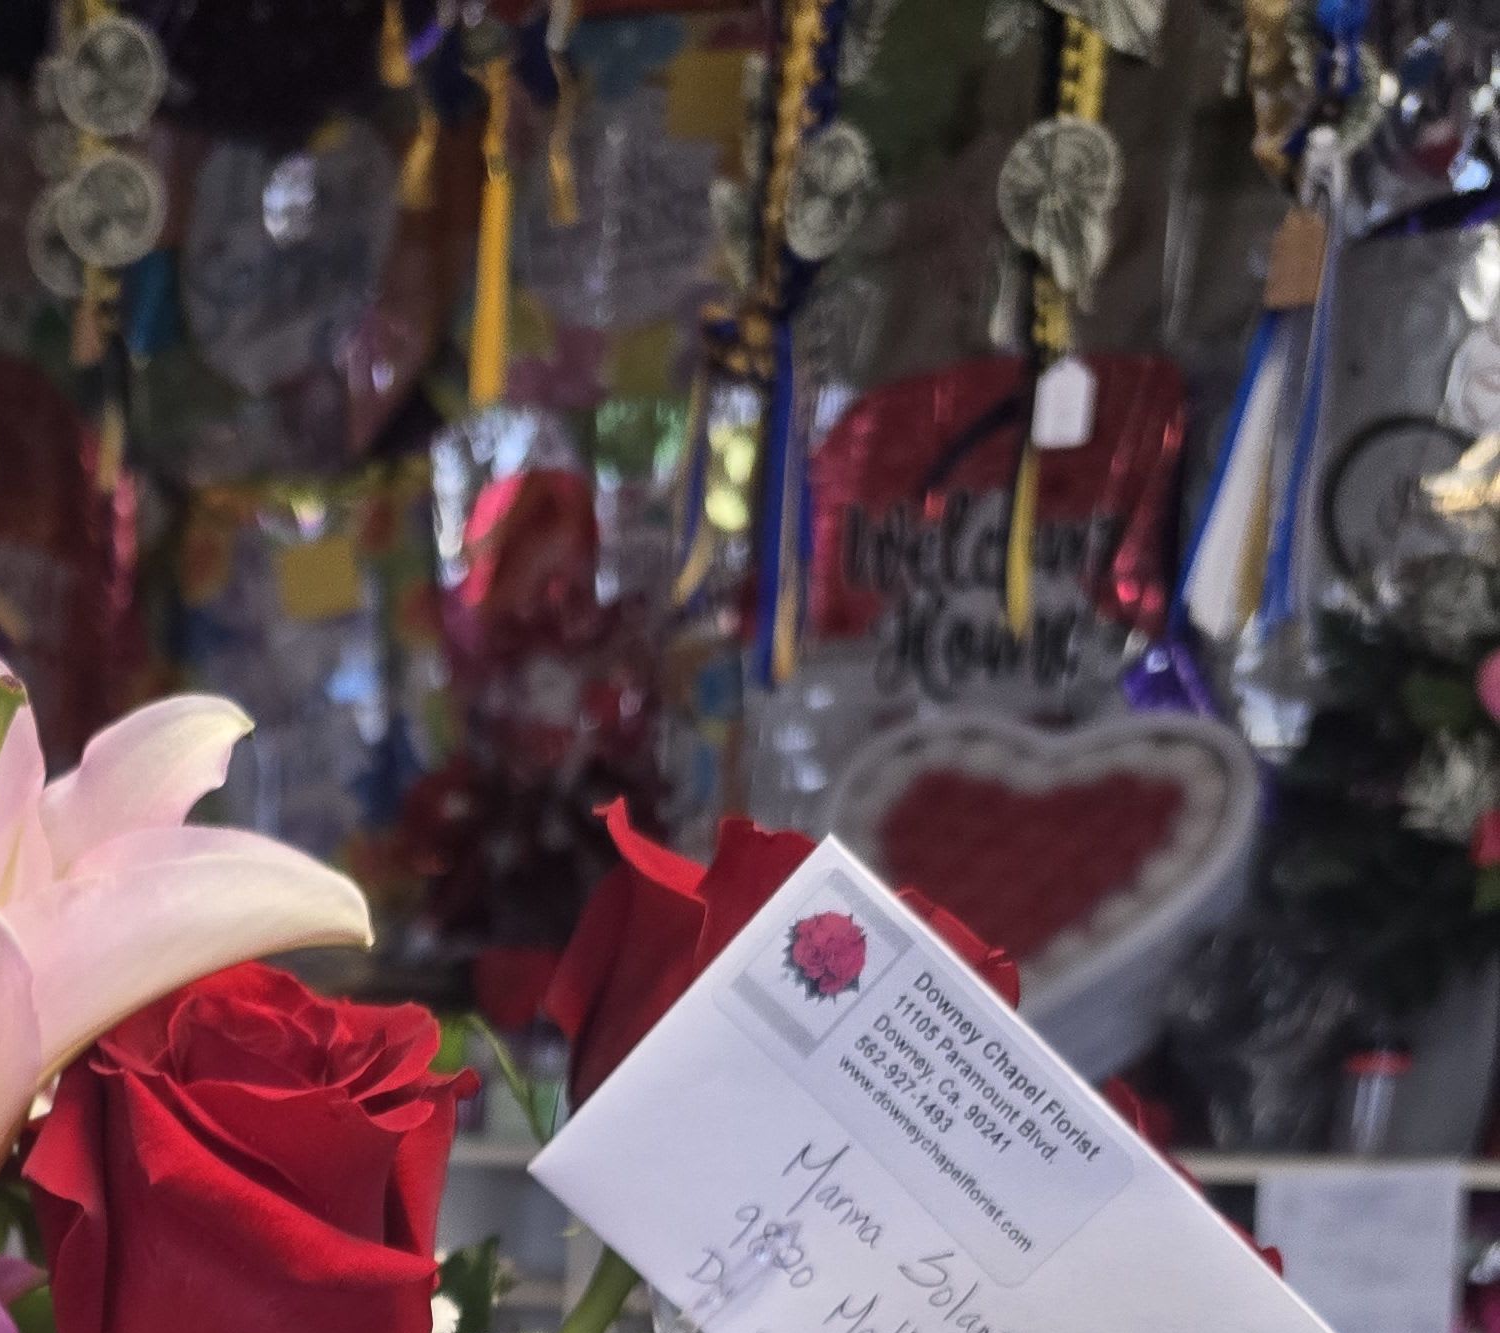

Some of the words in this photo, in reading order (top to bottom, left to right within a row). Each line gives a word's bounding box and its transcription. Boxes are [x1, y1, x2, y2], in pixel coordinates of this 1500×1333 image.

[854, 1035, 953, 1134] 562-927-1493
[873, 1014, 934, 1085] Downey,
[938, 1079, 962, 1109] Ca.
[964, 1104, 1012, 1154] 90241
[894, 994, 940, 1041] 11105
[935, 1036, 1020, 1123] Paramount
[1016, 1118, 1059, 1165] Blvd.
[913, 971, 982, 1045] Downey
[982, 1041, 1047, 1106] Chapel
[1040, 1100, 1101, 1162] Florist
[839, 1055, 1033, 1253] www.downeychapelflorist.com
